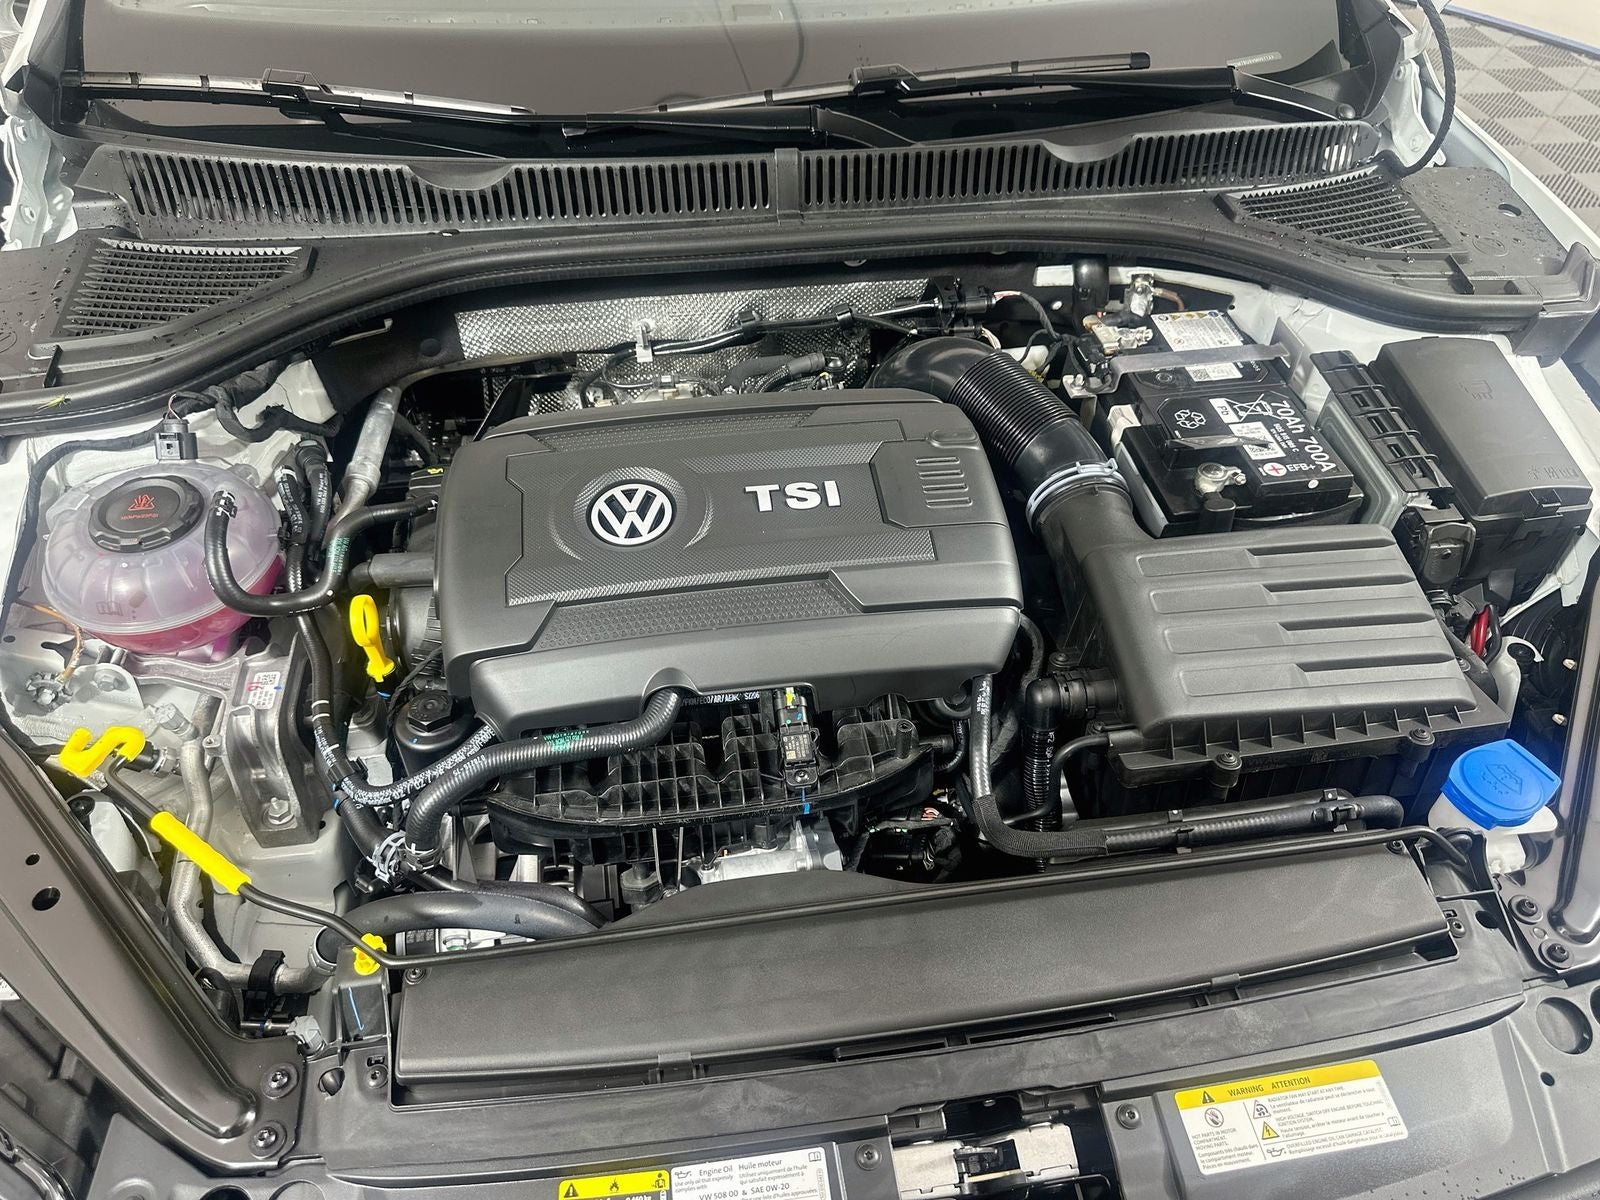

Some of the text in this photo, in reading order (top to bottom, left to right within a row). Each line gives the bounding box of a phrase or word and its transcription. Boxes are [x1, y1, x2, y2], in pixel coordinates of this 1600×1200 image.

[1271, 400, 1305, 433] 70Ah
[1298, 436, 1337, 472] 700A
[1286, 463, 1317, 472] EFB+
[745, 480, 841, 512] TSI
[591, 483, 673, 545] VW
[1228, 1077, 1310, 1096] WARNING ATTENTION
[699, 1167, 721, 1176] Engine
[738, 1159, 782, 1170] Huile moteur
[713, 1191, 727, 1199] 508
[728, 1189, 738, 1197] 00
[750, 1186, 764, 1194] SAE
[765, 1182, 790, 1192] 0W-20
